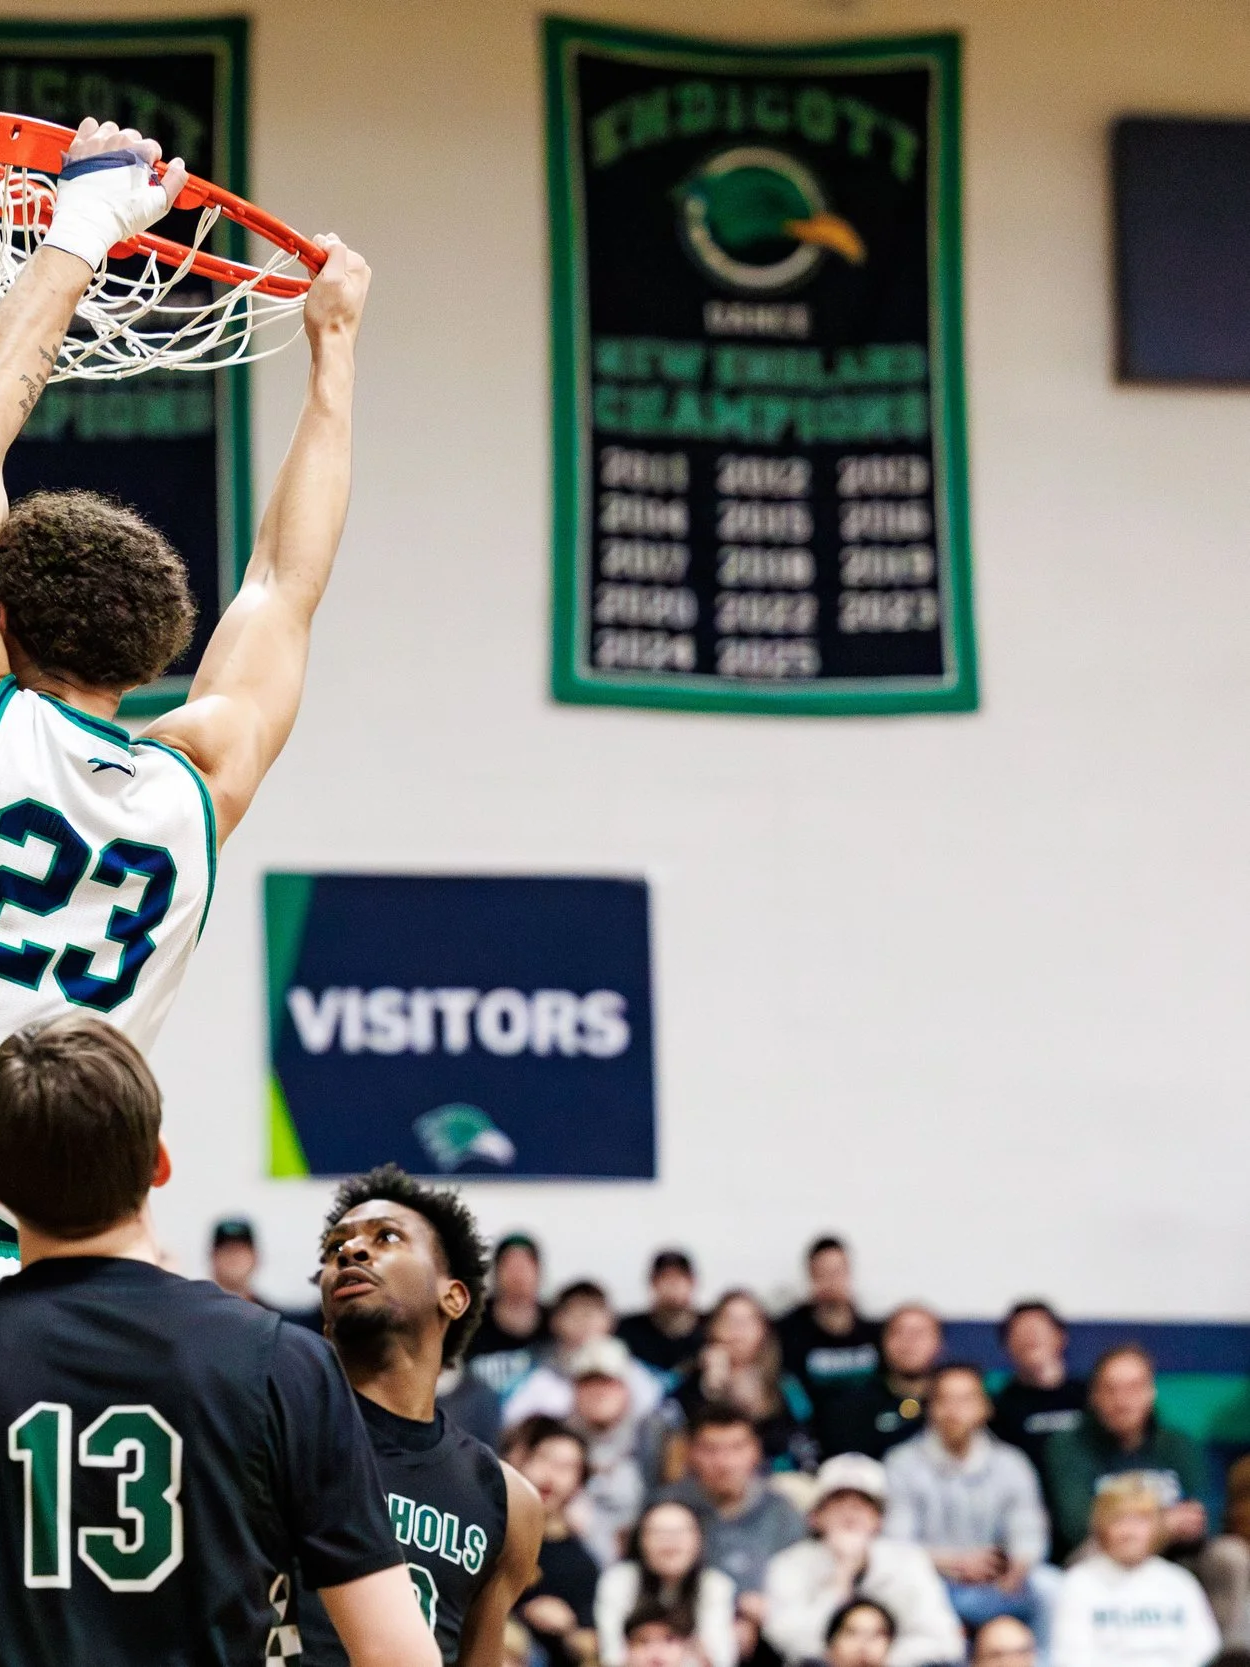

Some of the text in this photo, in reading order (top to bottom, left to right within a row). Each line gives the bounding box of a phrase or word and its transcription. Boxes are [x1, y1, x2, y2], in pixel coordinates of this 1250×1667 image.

[592, 80, 919, 183] ENDICOTT
[593, 384, 928, 444] CHAMPIONS
[286, 984, 632, 1060] VISITORS
[8, 1401, 184, 1593] 13
[382, 1492, 488, 1575] HOLS
